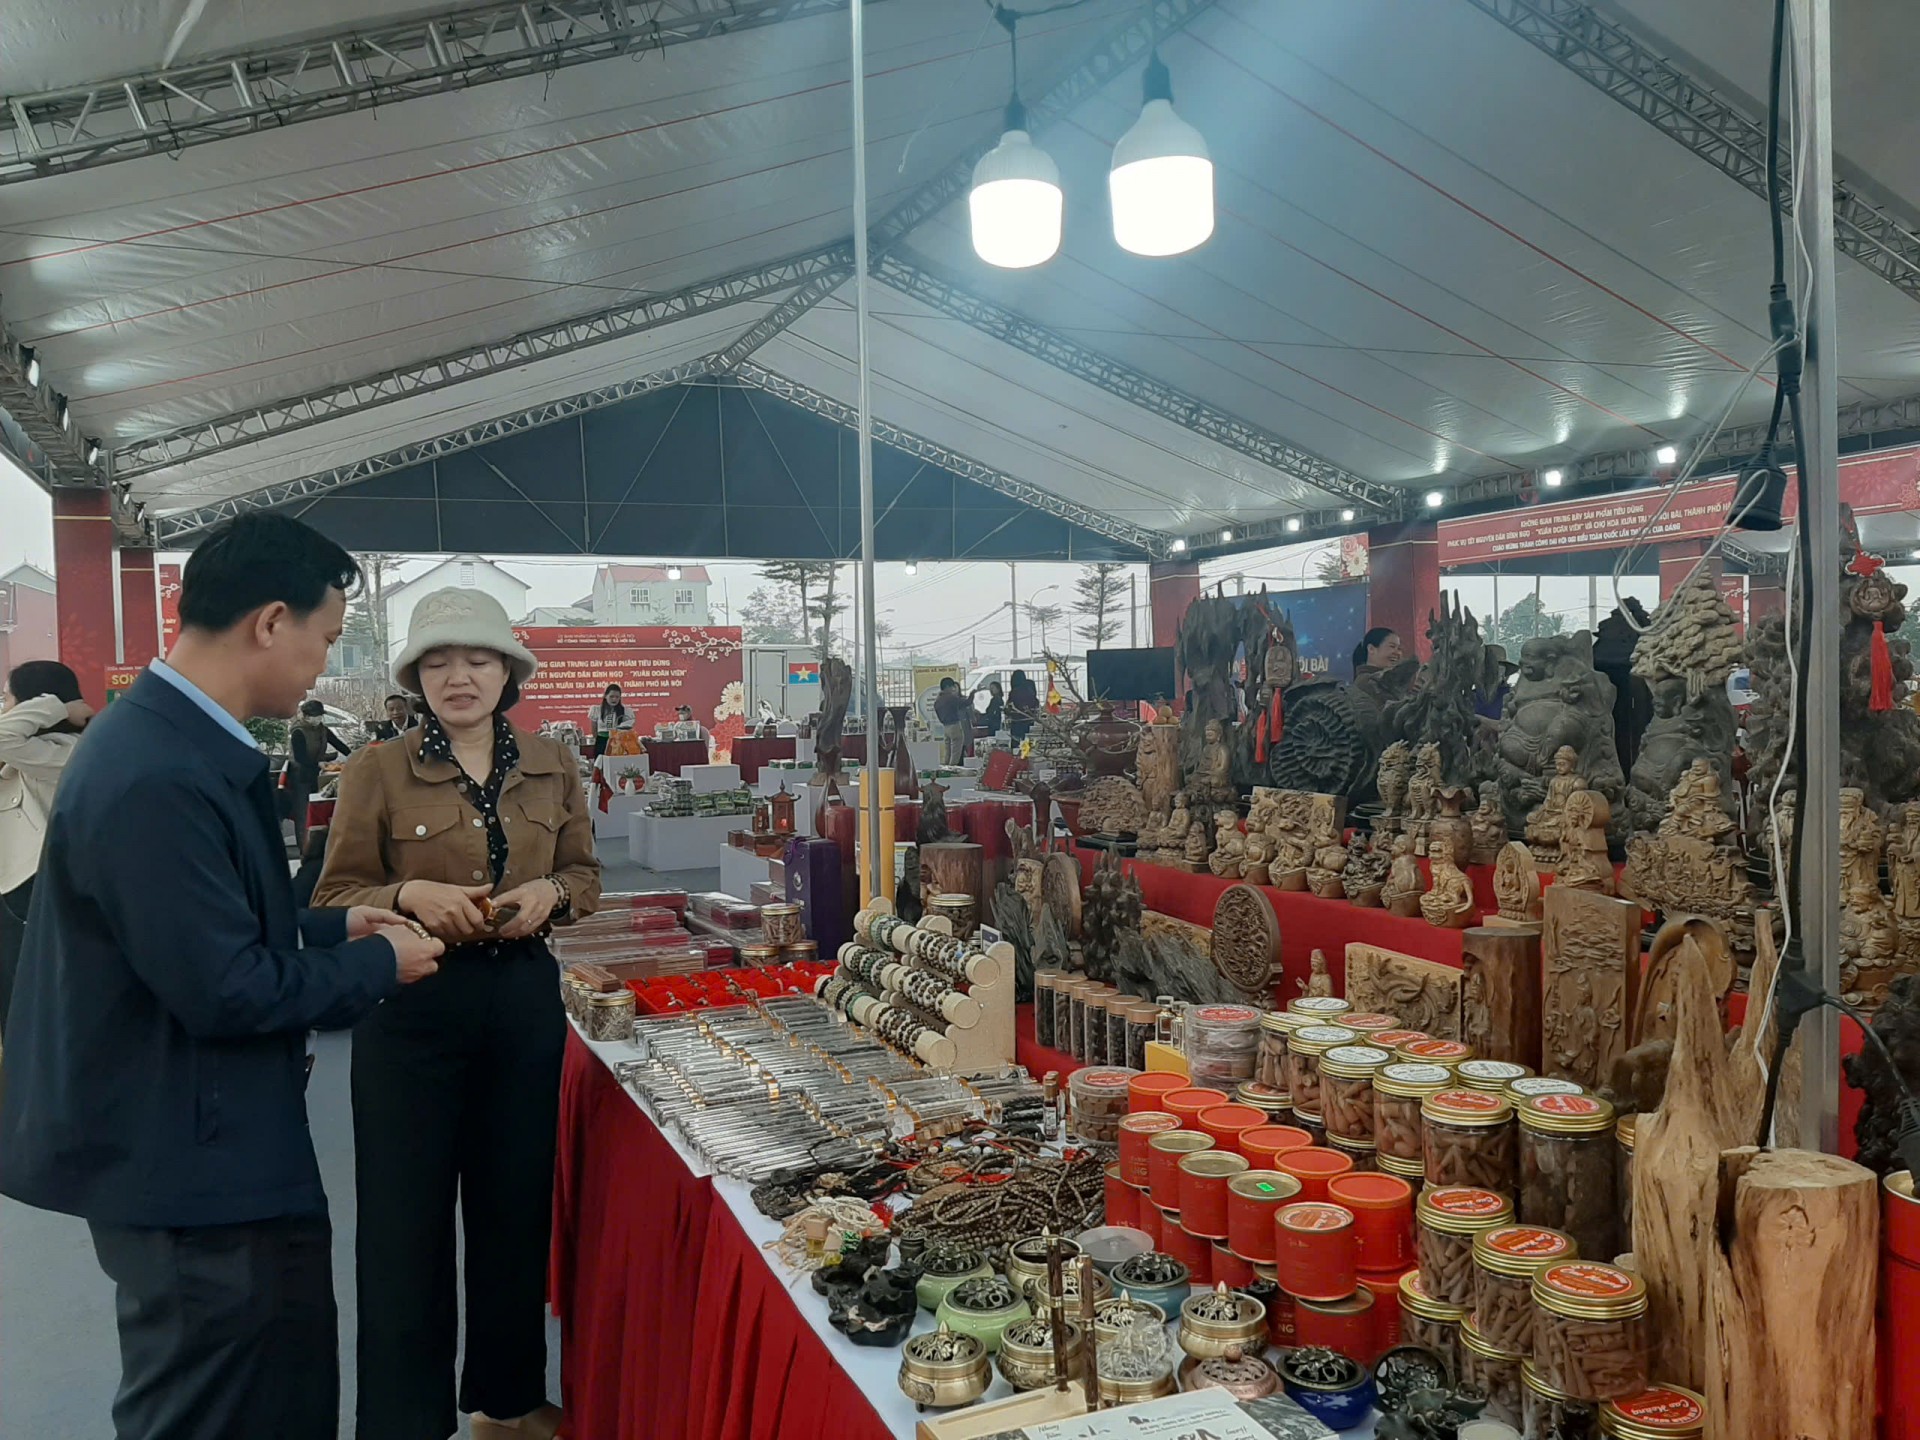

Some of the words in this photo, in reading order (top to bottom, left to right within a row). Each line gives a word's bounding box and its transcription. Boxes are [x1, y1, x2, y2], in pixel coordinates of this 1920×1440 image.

[1684, 506, 1706, 517] THÀNH
[1706, 502, 1722, 514] PHỐ
[1310, 654, 1329, 672] BÀI
